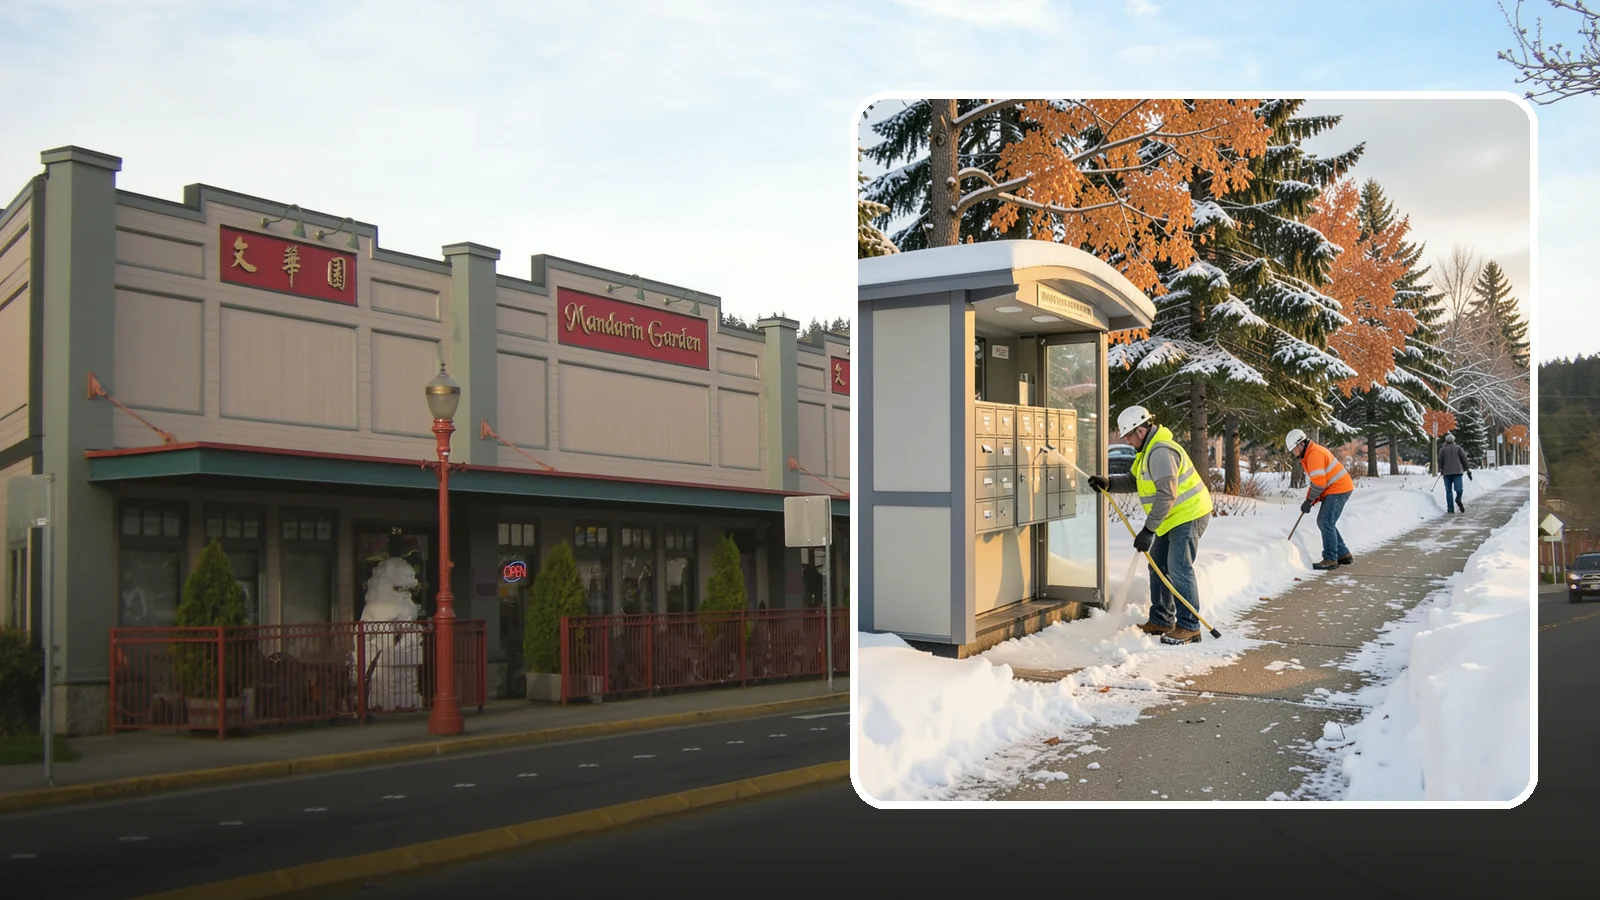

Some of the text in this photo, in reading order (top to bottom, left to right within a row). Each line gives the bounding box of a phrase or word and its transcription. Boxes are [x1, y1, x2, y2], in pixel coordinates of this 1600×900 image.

[564, 303, 701, 352] Mandarin Garden
[503, 565, 527, 578] OPEN
